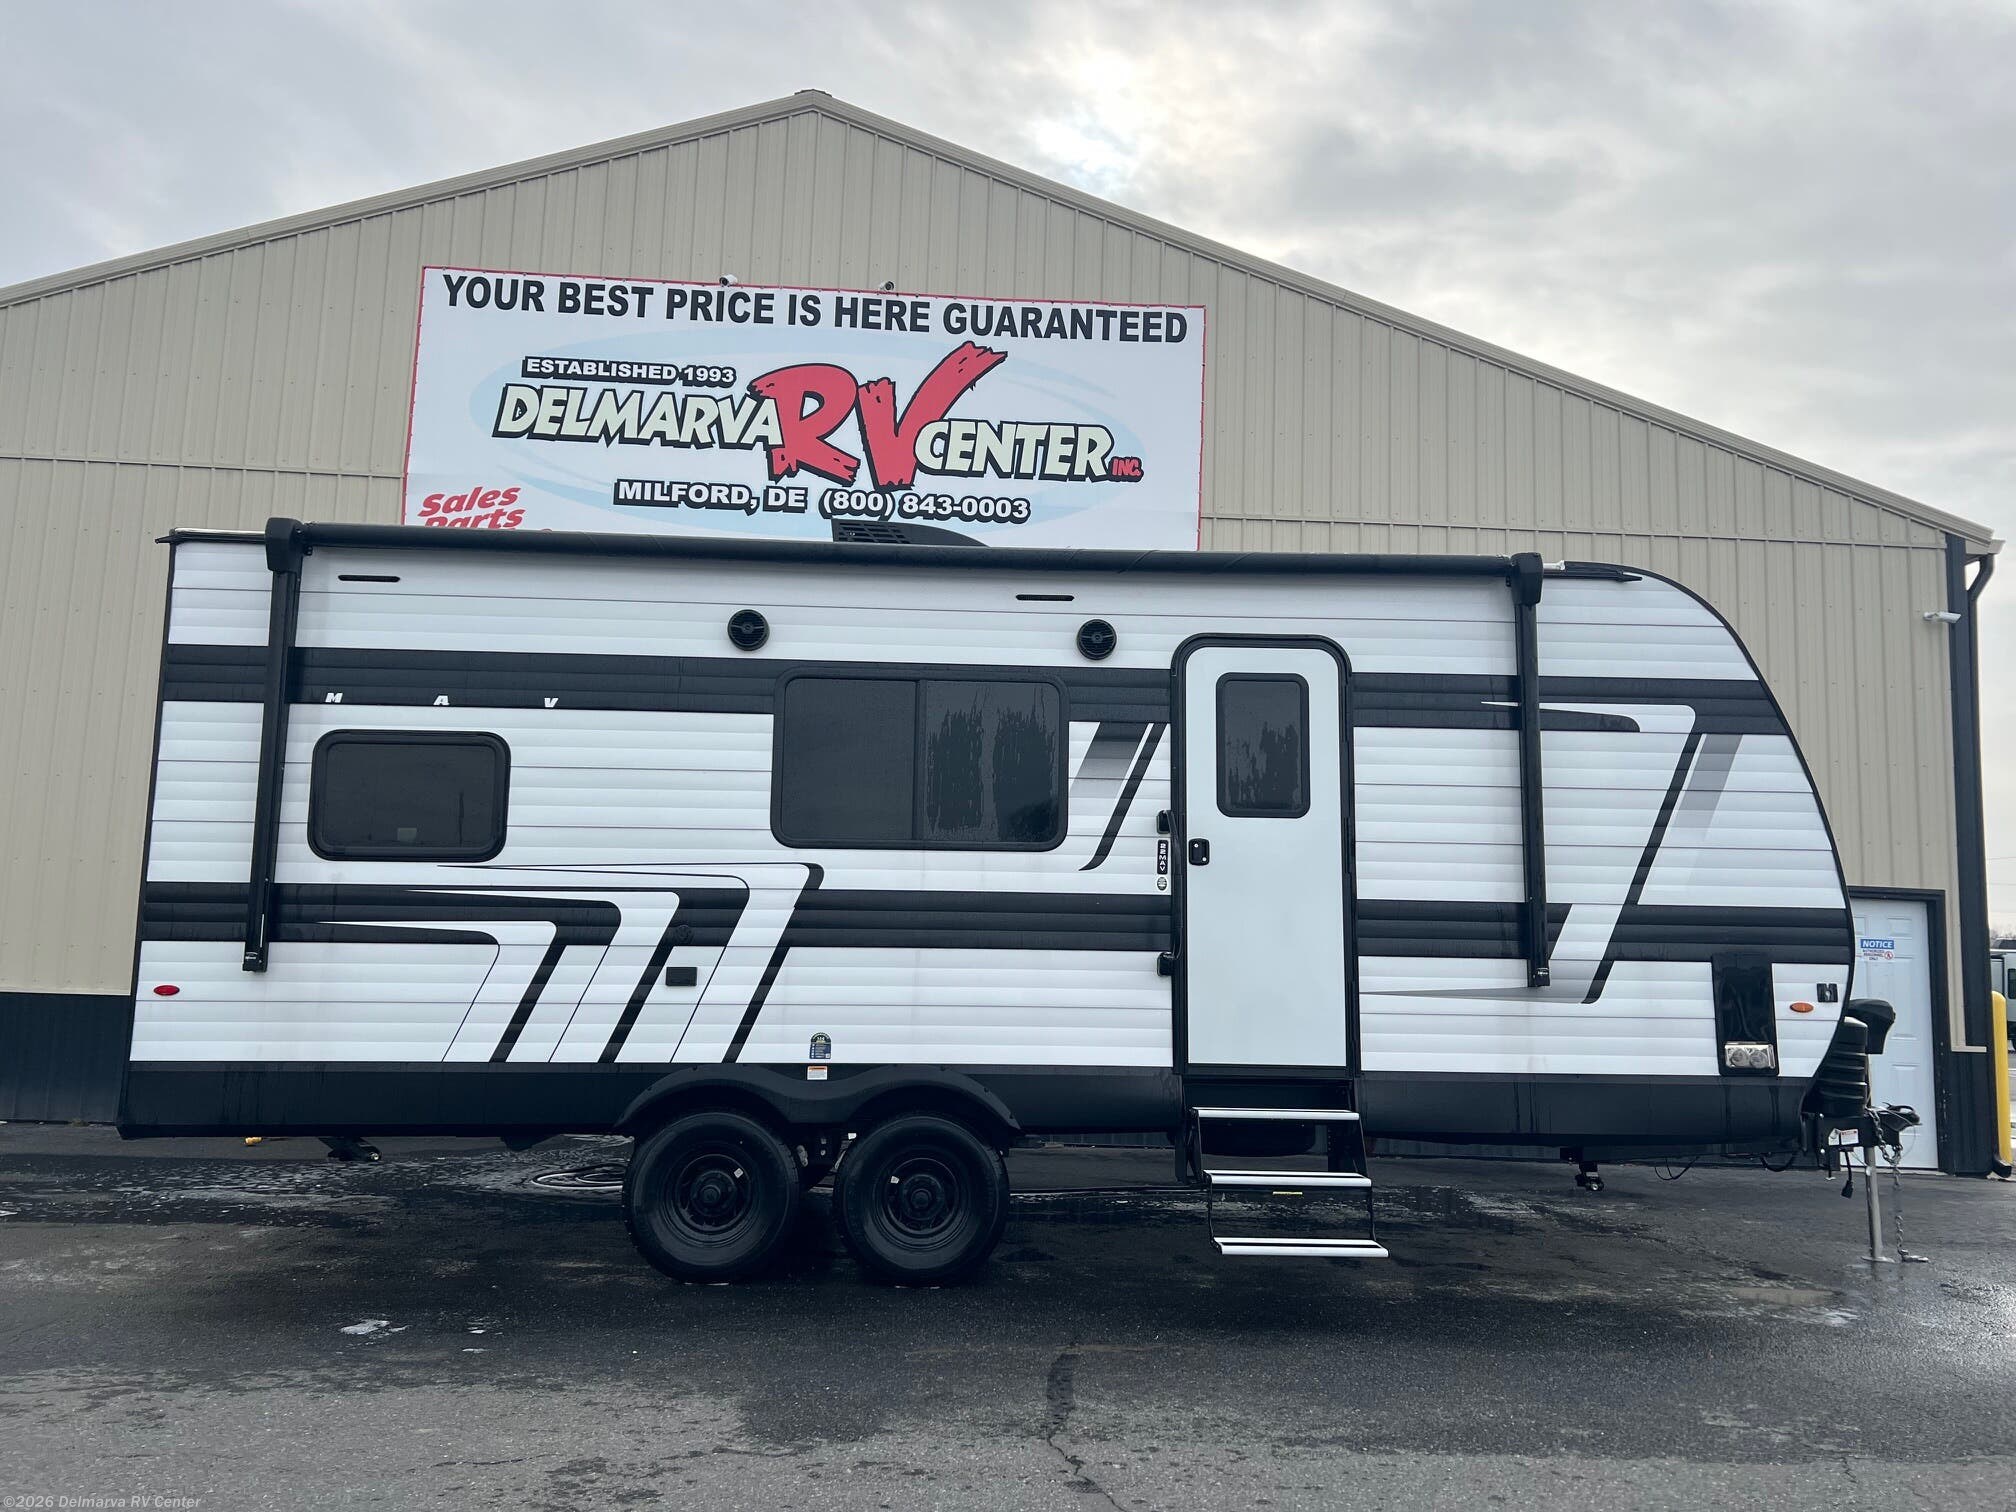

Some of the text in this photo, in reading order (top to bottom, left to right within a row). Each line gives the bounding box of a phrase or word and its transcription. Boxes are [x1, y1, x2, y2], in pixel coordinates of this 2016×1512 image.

[443, 274, 1188, 343] YOUR BEST PRICE IS HERE GUARANTEED
[525, 358, 735, 383] ESTABLISHED 1993
[495, 384, 785, 448] DELMARVA
[748, 341, 1007, 490] RV
[914, 420, 1114, 479] CENTER
[417, 486, 522, 517] Sales
[617, 481, 1029, 519] MILFORD, DE (800) 843-0003
[1862, 940, 1893, 949] NOTICE
